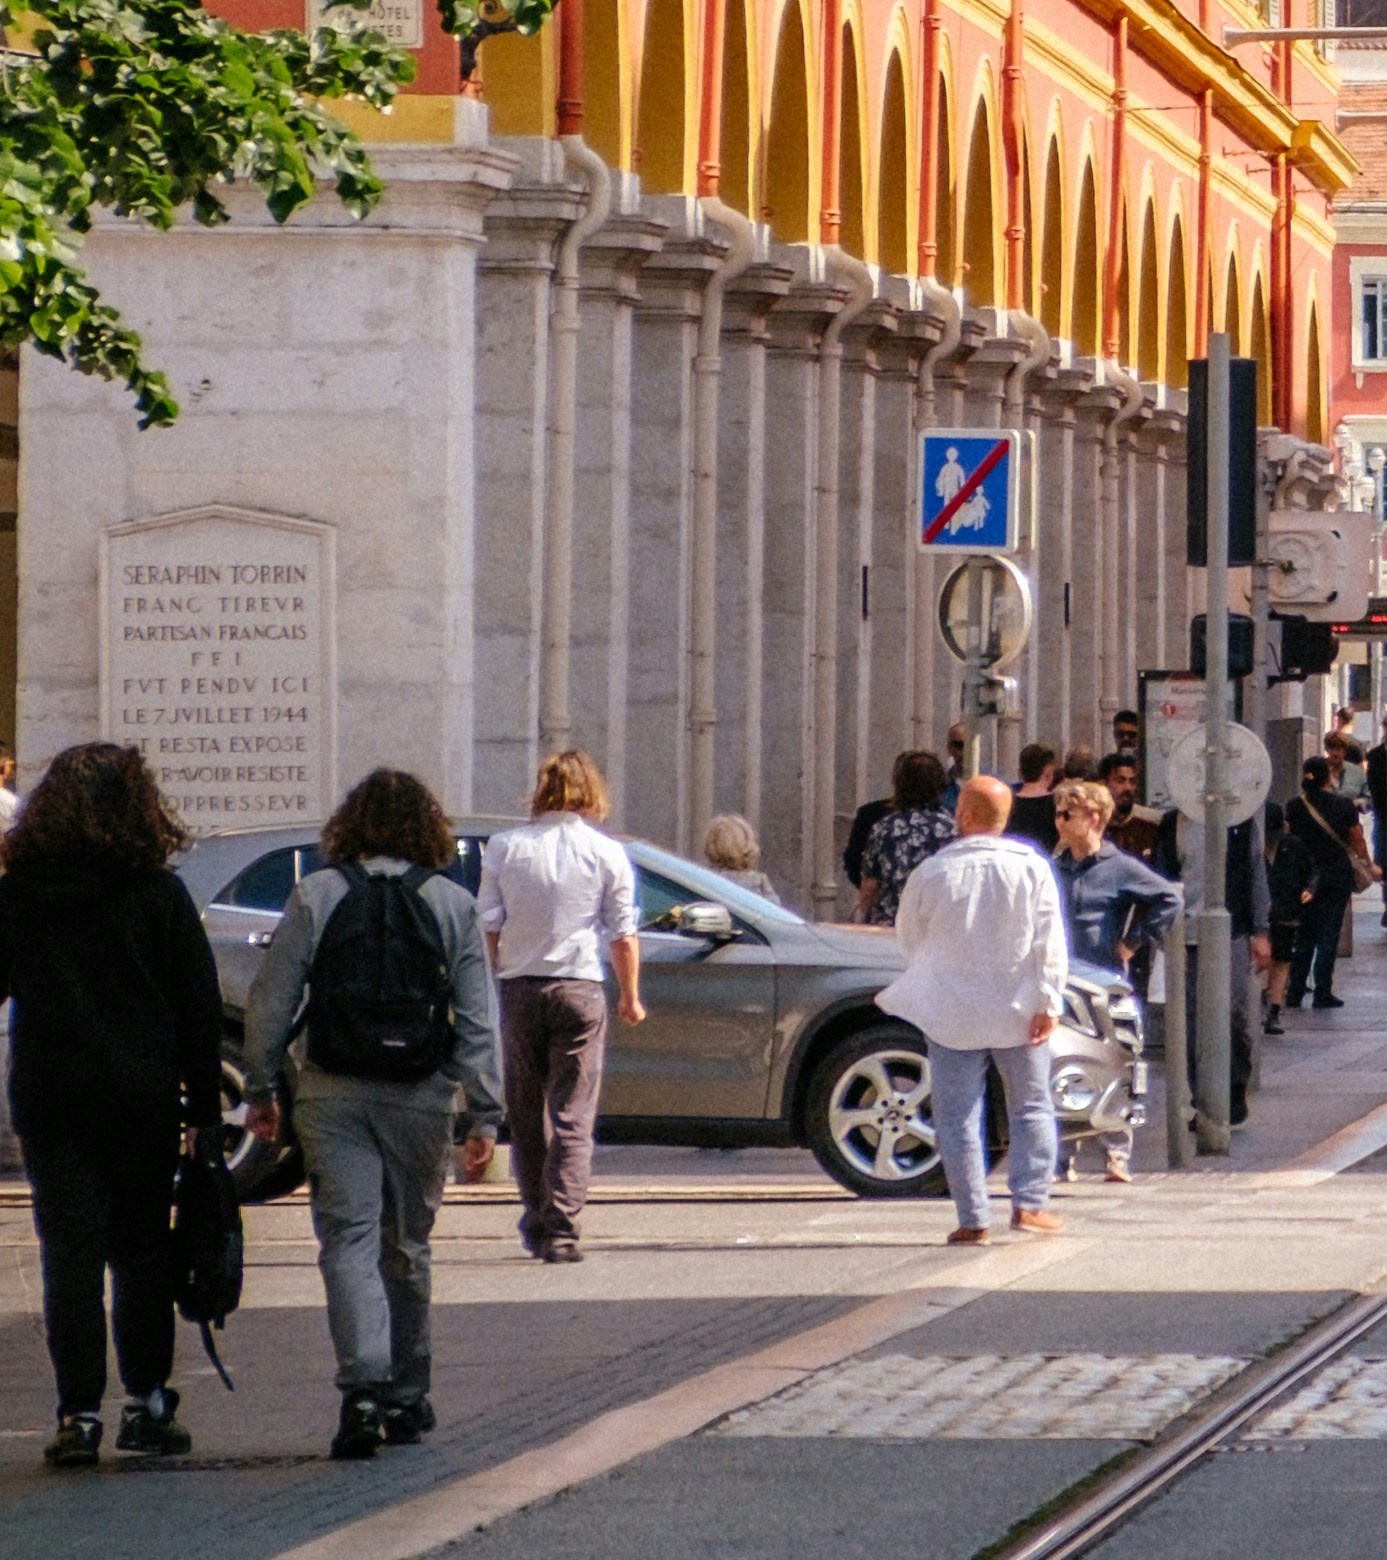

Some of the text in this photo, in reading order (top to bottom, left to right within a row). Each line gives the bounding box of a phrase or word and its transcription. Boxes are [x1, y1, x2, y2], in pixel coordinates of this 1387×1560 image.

[123, 565, 220, 585] SERAPHIN
[123, 597, 304, 613] FRANC TIREVR
[123, 626, 211, 641] PARTISAN
[123, 677, 308, 695] FVT PENDV ICI
[123, 707, 308, 724] LE 7 JVILLET 1944
[160, 737, 220, 753] RESTA
[229, 736, 307, 752] EXPOSE
[236, 766, 309, 782] RESISTE
